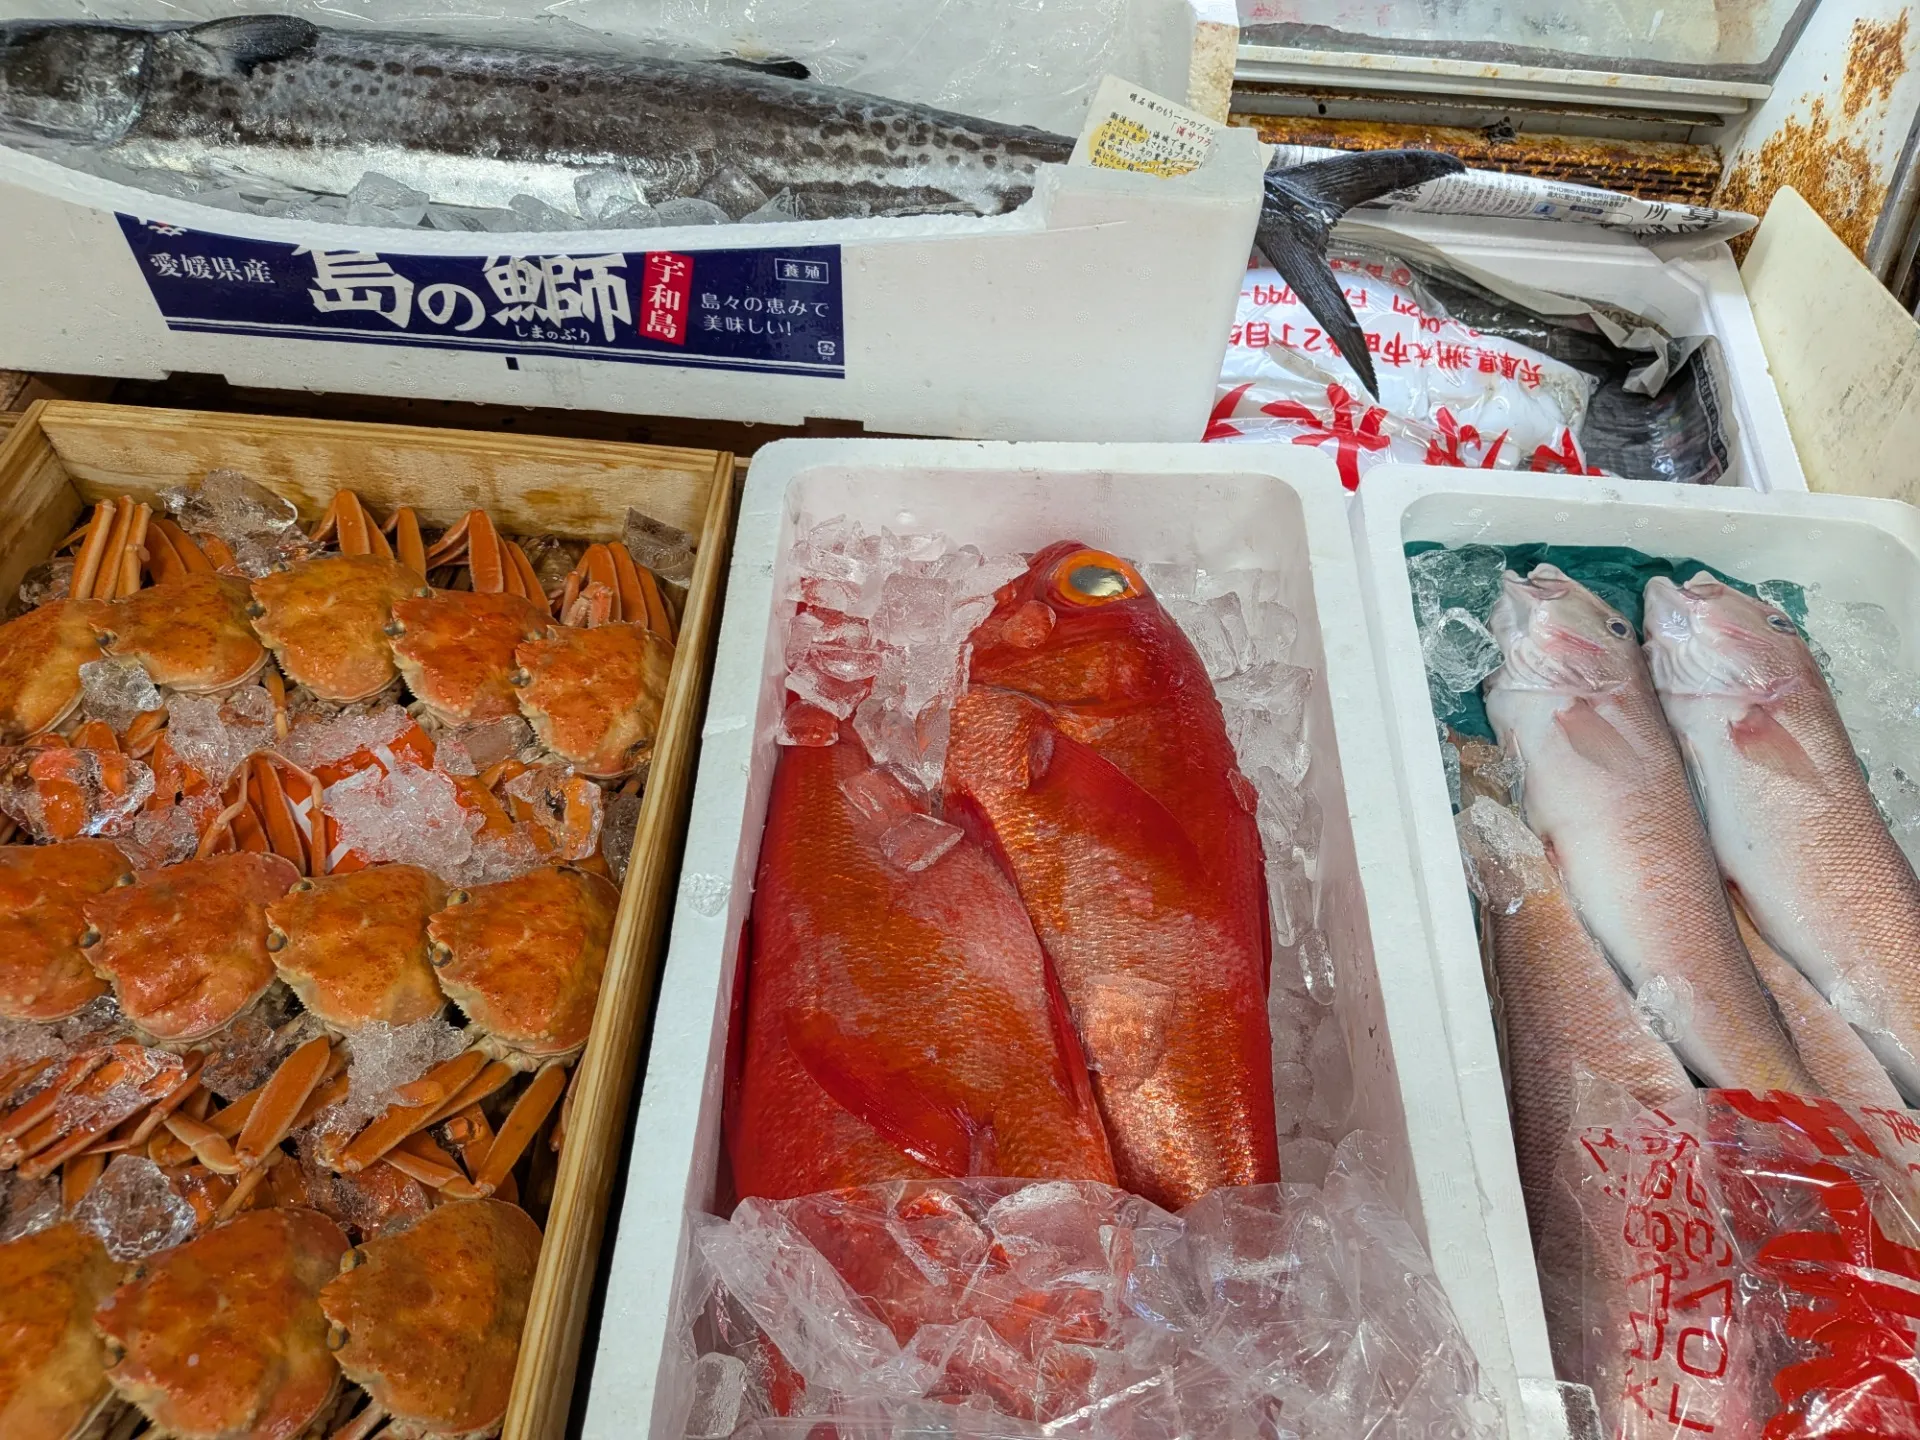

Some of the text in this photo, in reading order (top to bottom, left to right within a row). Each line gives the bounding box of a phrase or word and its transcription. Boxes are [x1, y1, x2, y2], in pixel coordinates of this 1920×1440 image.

[150, 252, 276, 284] 愛媛県産
[783, 263, 821, 280] 養殖
[646, 255, 685, 339] 宇和島
[701, 292, 830, 318] 島々の恵みで
[515, 325, 591, 343] しまのぶり
[703, 314, 792, 336] 美味しい!
